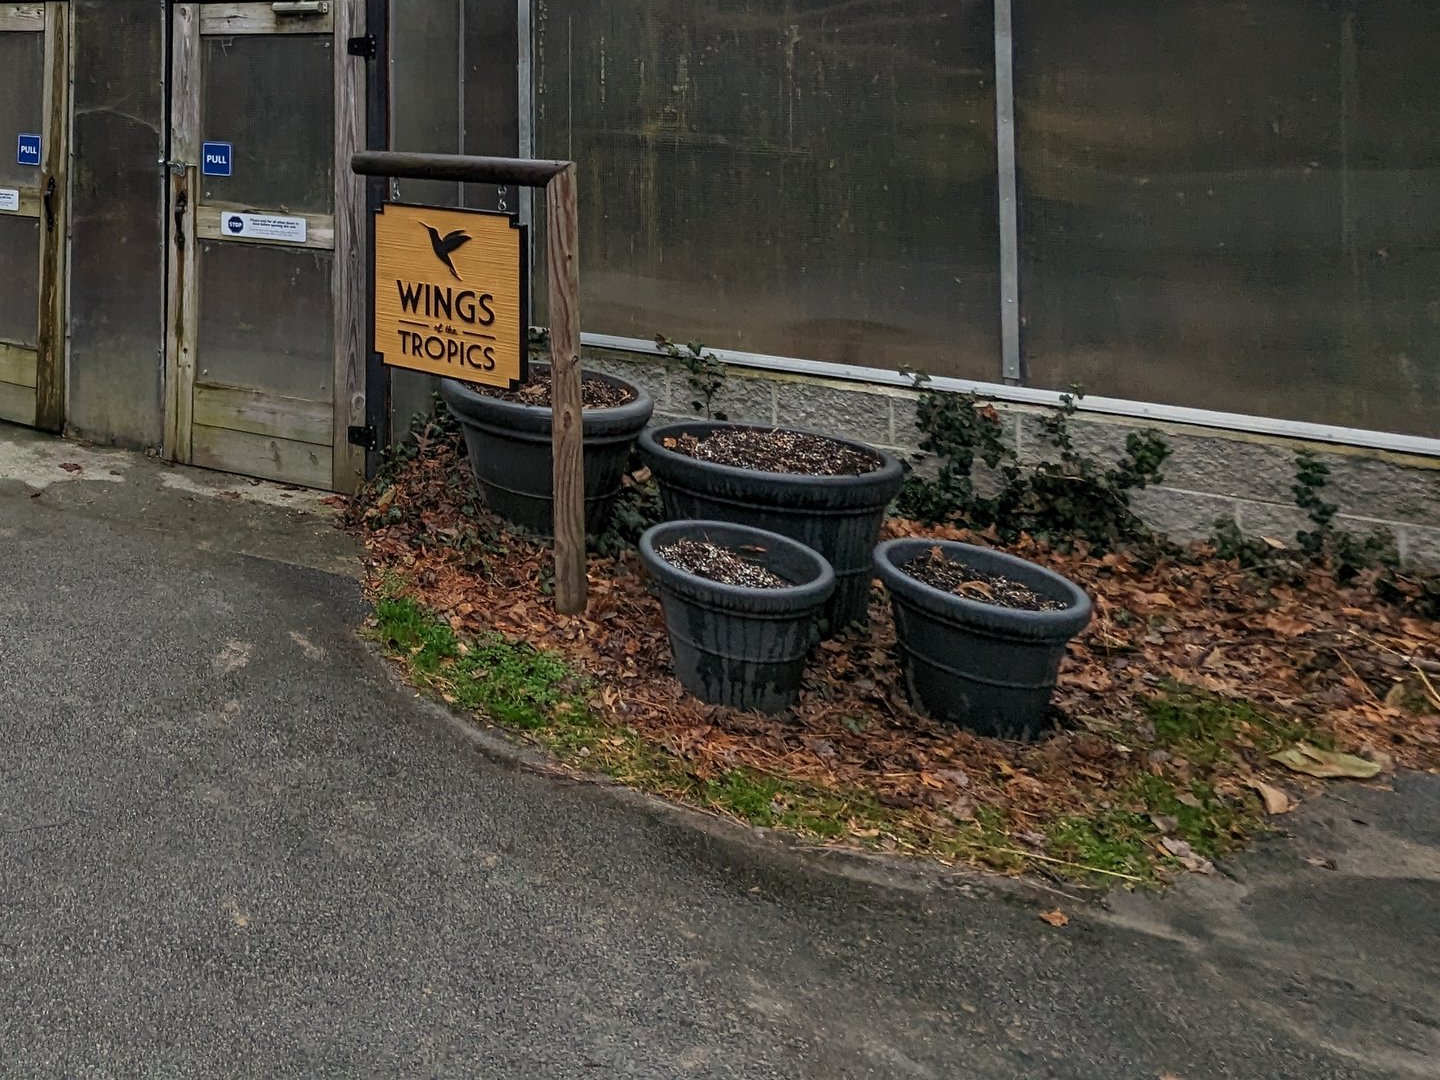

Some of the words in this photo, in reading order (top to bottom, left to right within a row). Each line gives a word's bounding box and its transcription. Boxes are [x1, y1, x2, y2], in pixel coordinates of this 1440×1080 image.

[20, 145, 37, 154] PULL
[206, 154, 227, 164] PULL
[396, 279, 495, 327] WINGS
[433, 323, 443, 333] of
[445, 324, 458, 335] the
[397, 329, 496, 371] TROPICS
